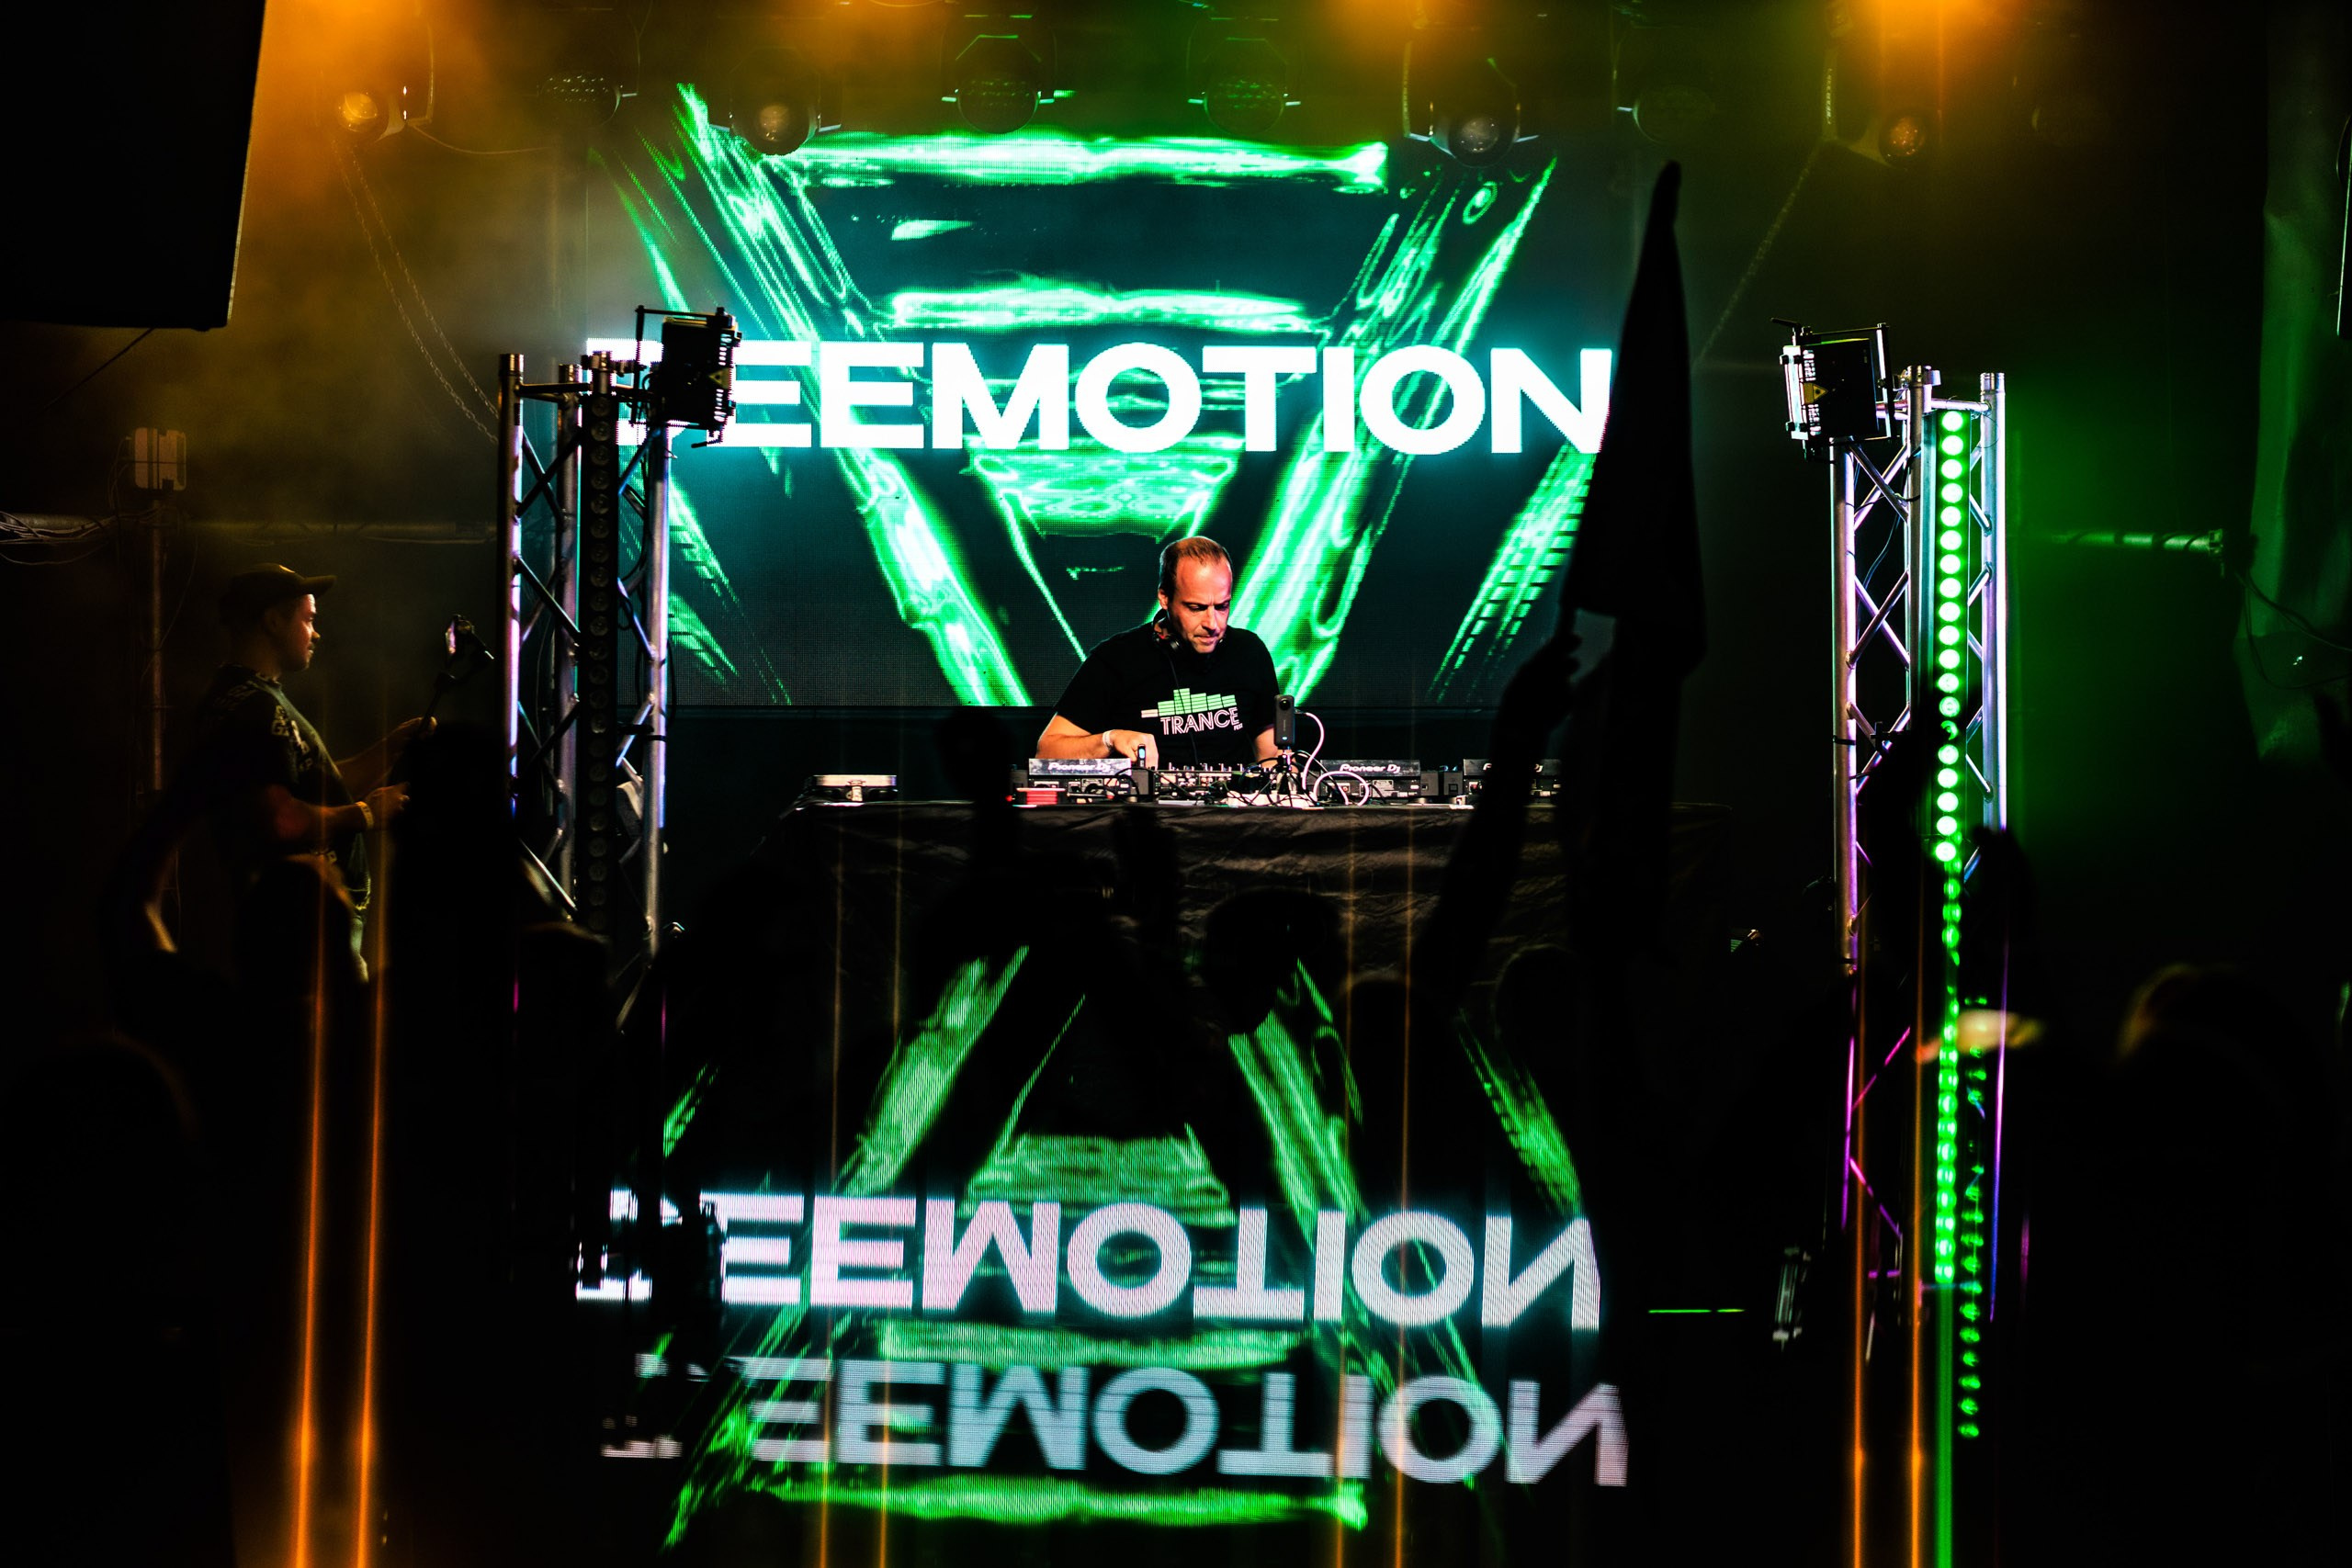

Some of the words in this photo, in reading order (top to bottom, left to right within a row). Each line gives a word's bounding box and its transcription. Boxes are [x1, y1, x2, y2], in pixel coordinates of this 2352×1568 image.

[1160, 706, 1239, 735] TRANCE
[1047, 761, 1096, 772] Pioneer
[1340, 763, 1385, 773] Pioneer
